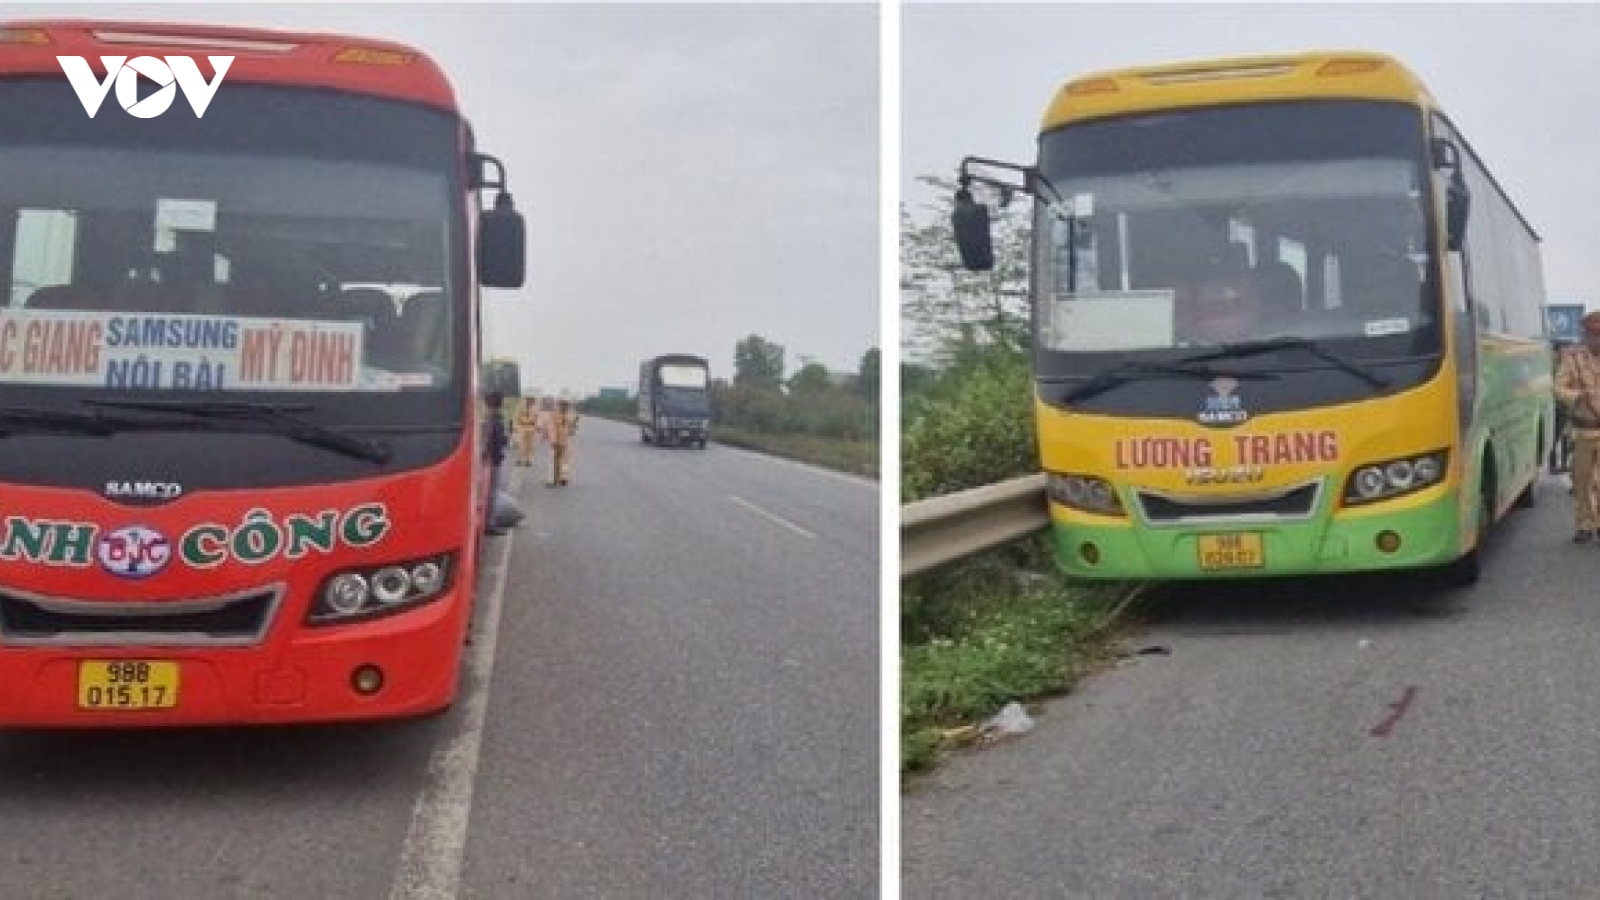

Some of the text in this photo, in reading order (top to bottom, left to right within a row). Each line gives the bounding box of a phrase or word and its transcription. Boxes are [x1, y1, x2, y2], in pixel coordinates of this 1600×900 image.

[23, 318, 101, 374] GIANG
[106, 316, 239, 349] SAMSUNG
[1233, 430, 1341, 466] TRANG
[104, 480, 182, 498] SAMCO
[179, 502, 391, 569] CÔNG
[86, 684, 167, 706] 015.17
